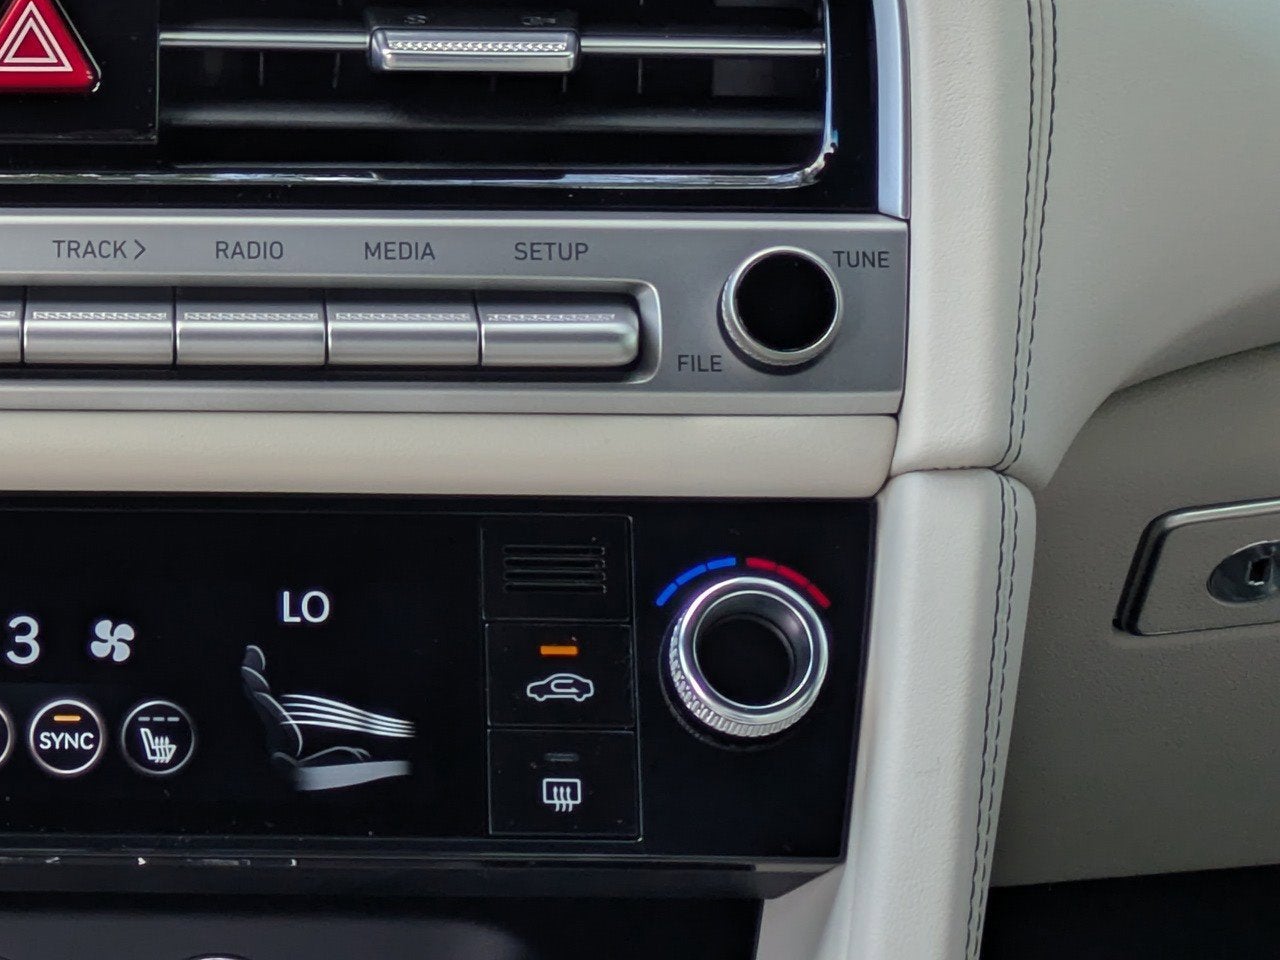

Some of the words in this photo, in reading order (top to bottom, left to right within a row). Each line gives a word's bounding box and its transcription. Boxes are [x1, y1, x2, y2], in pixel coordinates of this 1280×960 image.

[215, 240, 284, 260] RADIO
[364, 241, 436, 261] MEDIA
[514, 241, 589, 261] SETUP
[832, 250, 890, 269] TUNE
[677, 354, 723, 373] FILE
[283, 590, 330, 623] LO
[6, 615, 41, 665] 3
[38, 730, 95, 751] SYNC
